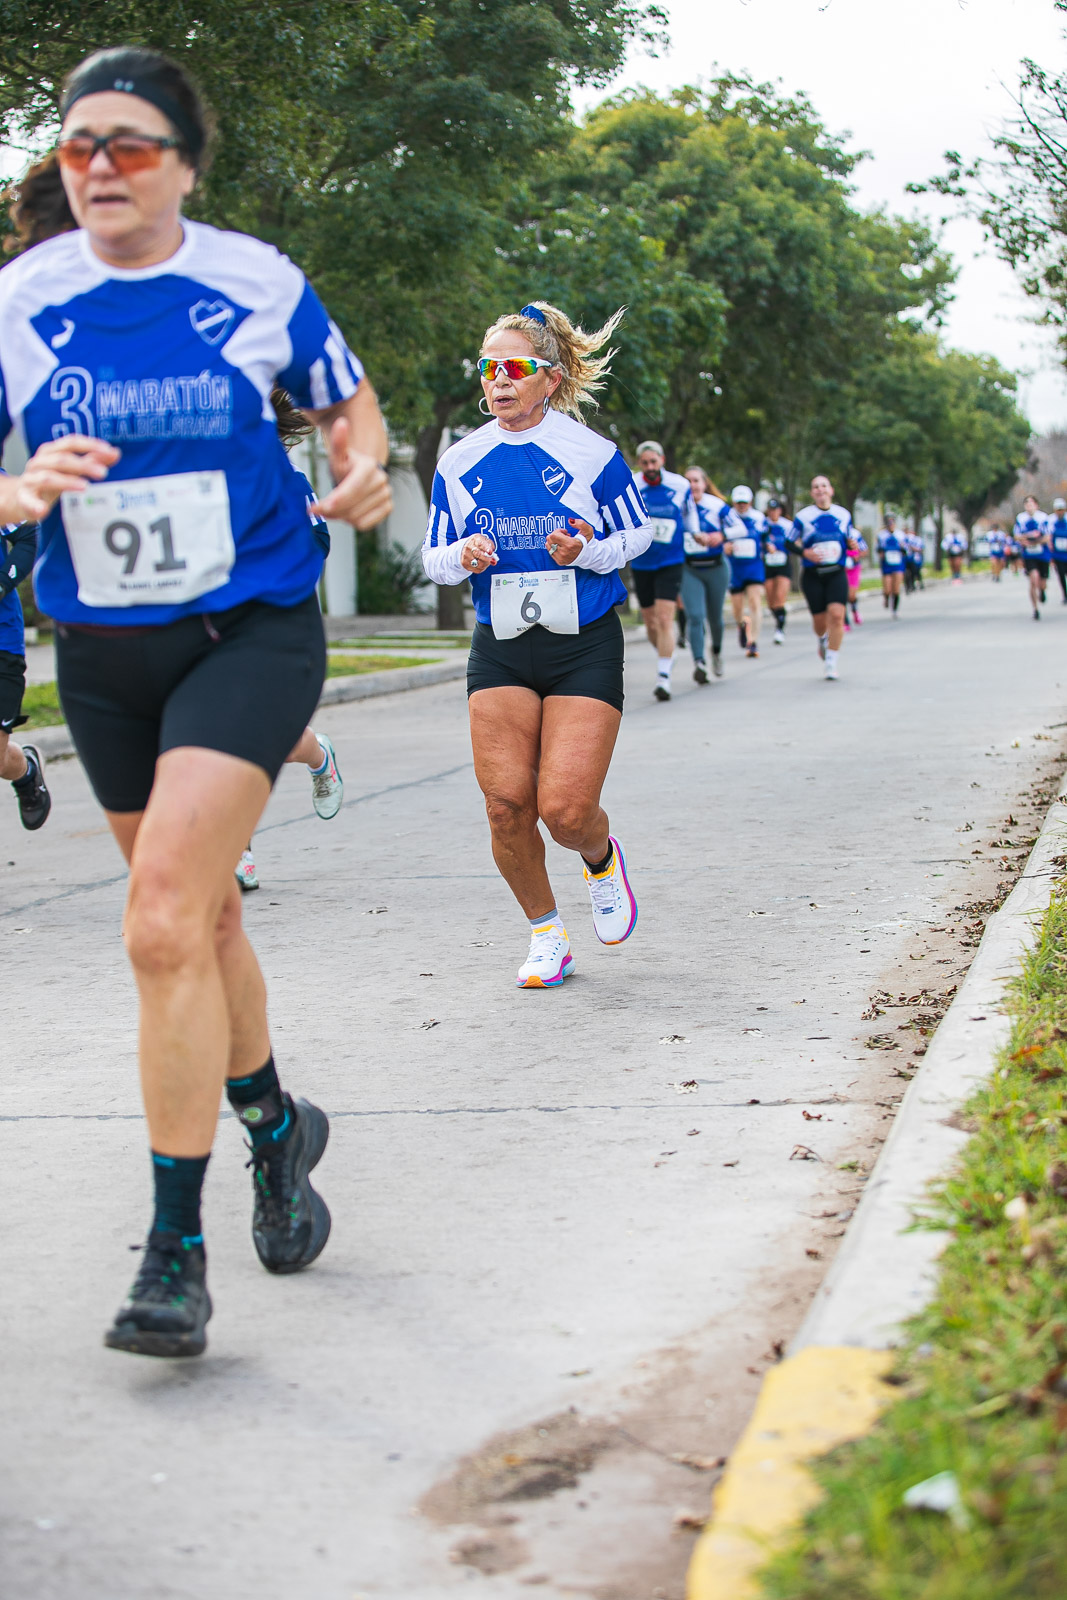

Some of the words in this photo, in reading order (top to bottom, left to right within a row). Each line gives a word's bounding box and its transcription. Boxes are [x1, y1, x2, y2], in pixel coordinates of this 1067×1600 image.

[50, 366, 95, 440] 3
[96, 369, 233, 419] MARATÓN
[105, 515, 187, 575] 91
[475, 508, 498, 551] 3
[496, 512, 566, 537] MARATÓN
[499, 535, 548, 550] C.A.BELGR
[520, 591, 542, 624] 6
